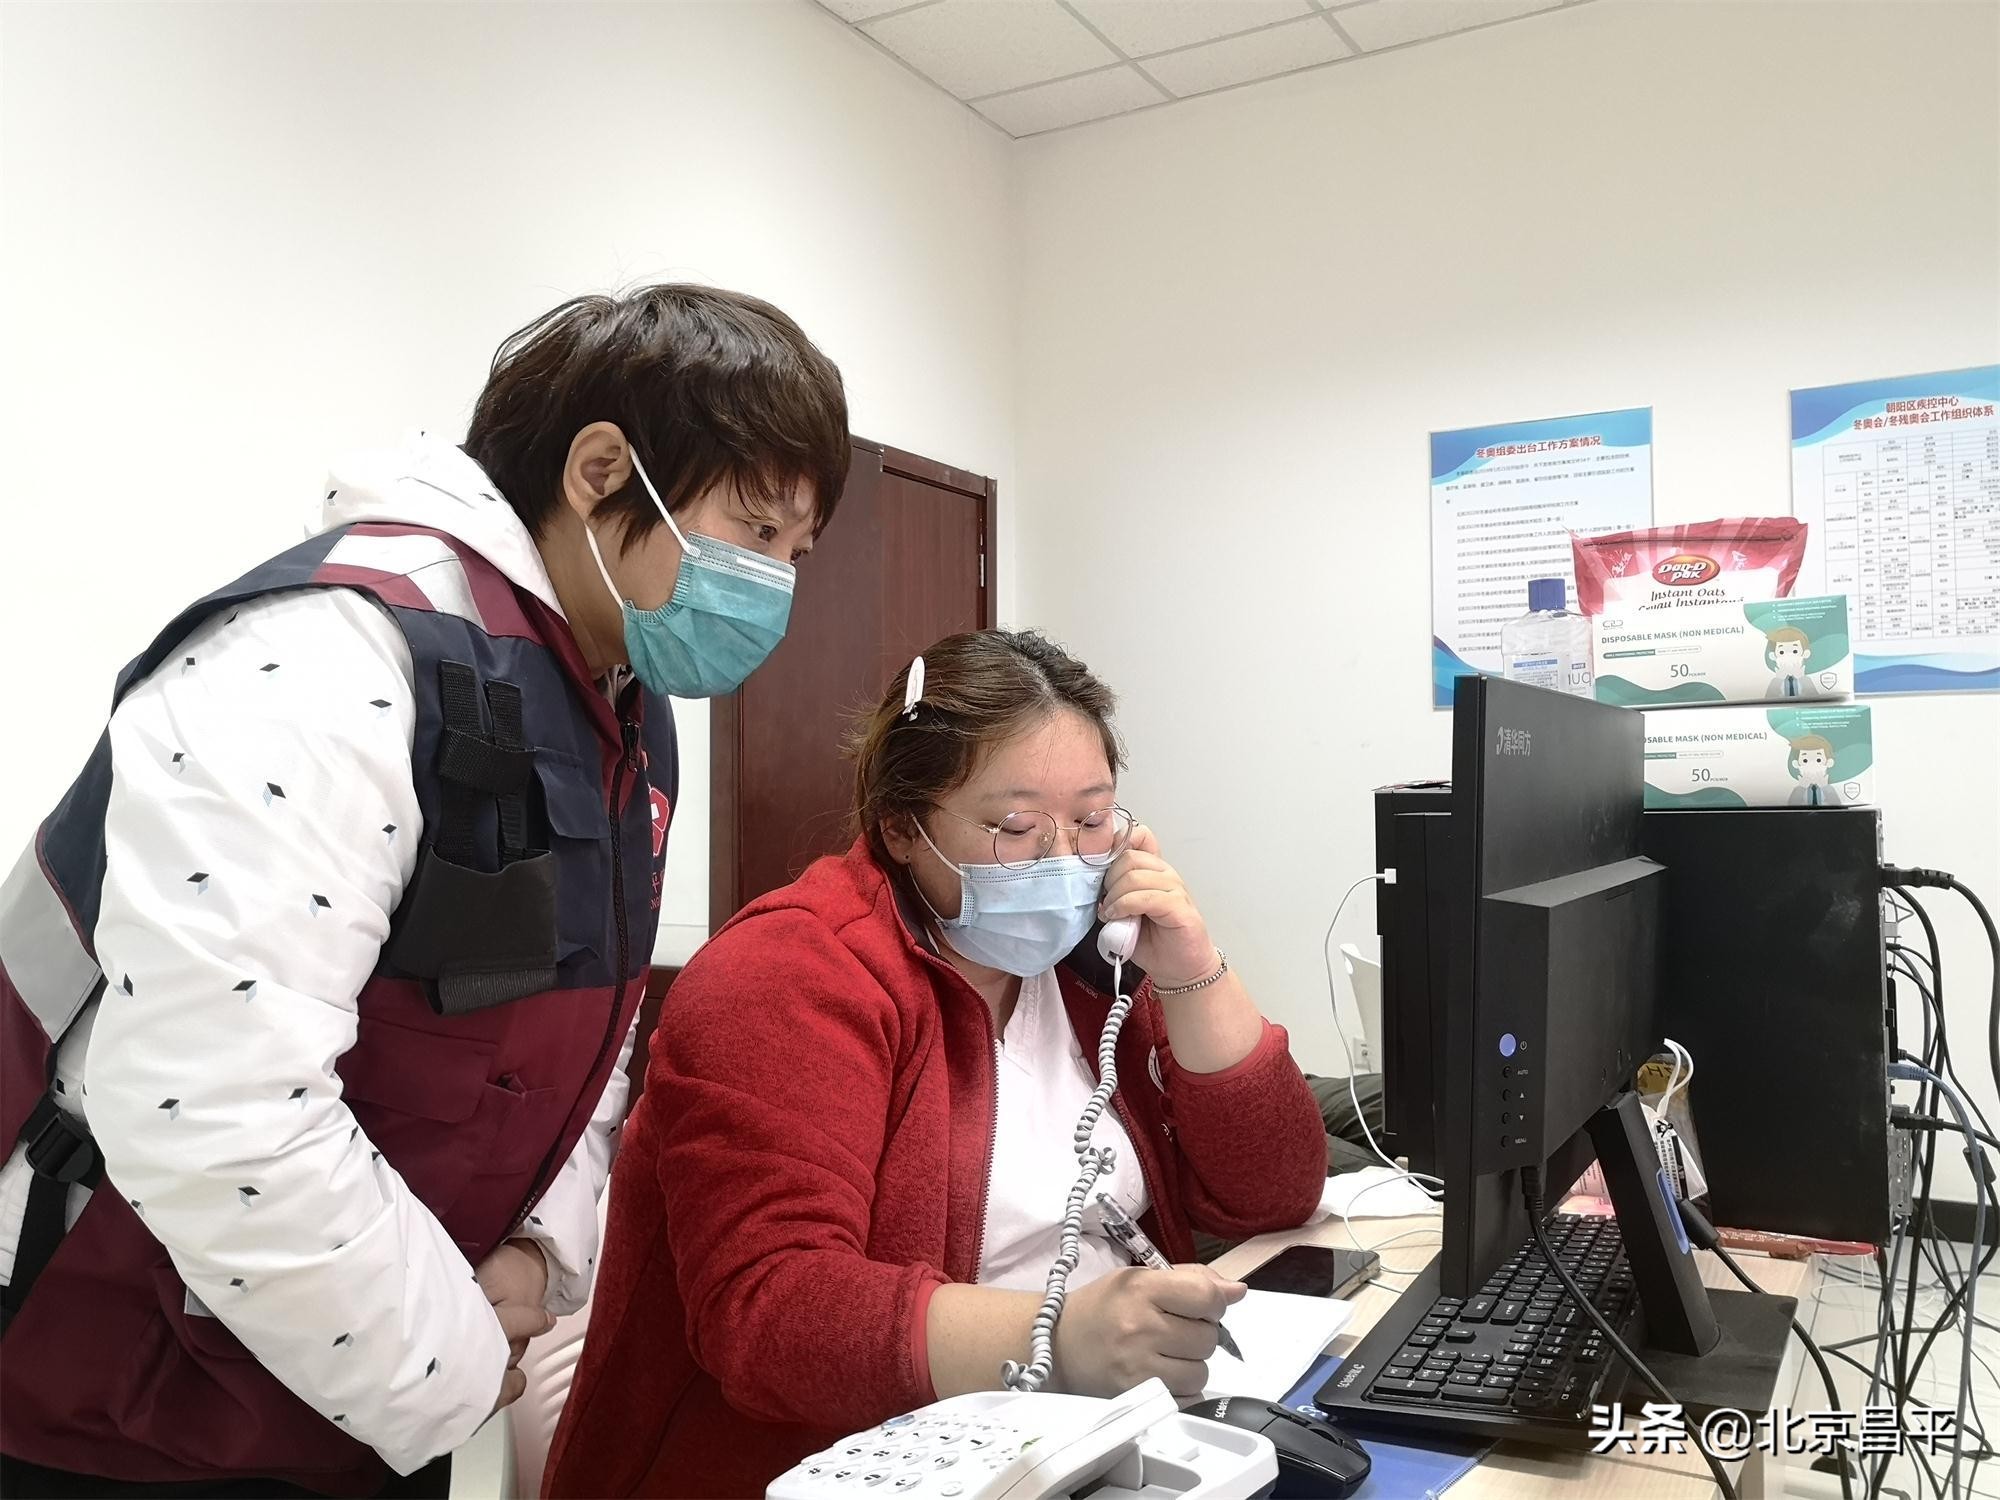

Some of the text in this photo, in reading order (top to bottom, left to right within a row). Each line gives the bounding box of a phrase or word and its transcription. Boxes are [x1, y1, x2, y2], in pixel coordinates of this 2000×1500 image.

[1885, 396, 1959, 413] 朝阳区疾控中心
[1853, 405, 1995, 430] 冬奥会/冬残奥会工作组织体系
[1475, 435, 1602, 459] 冬奥组委出台工作方案情况
[1651, 588, 1726, 601] Instant Oats
[1601, 625, 1744, 644] DISPOSABLE MASK (NON MEDICAL)
[1670, 664, 1689, 678] 50
[1676, 734, 1699, 743] MASK
[1701, 733, 1723, 743] (NON
[1725, 732, 1767, 741] MEDICAL)
[1692, 768, 1710, 782] 50
